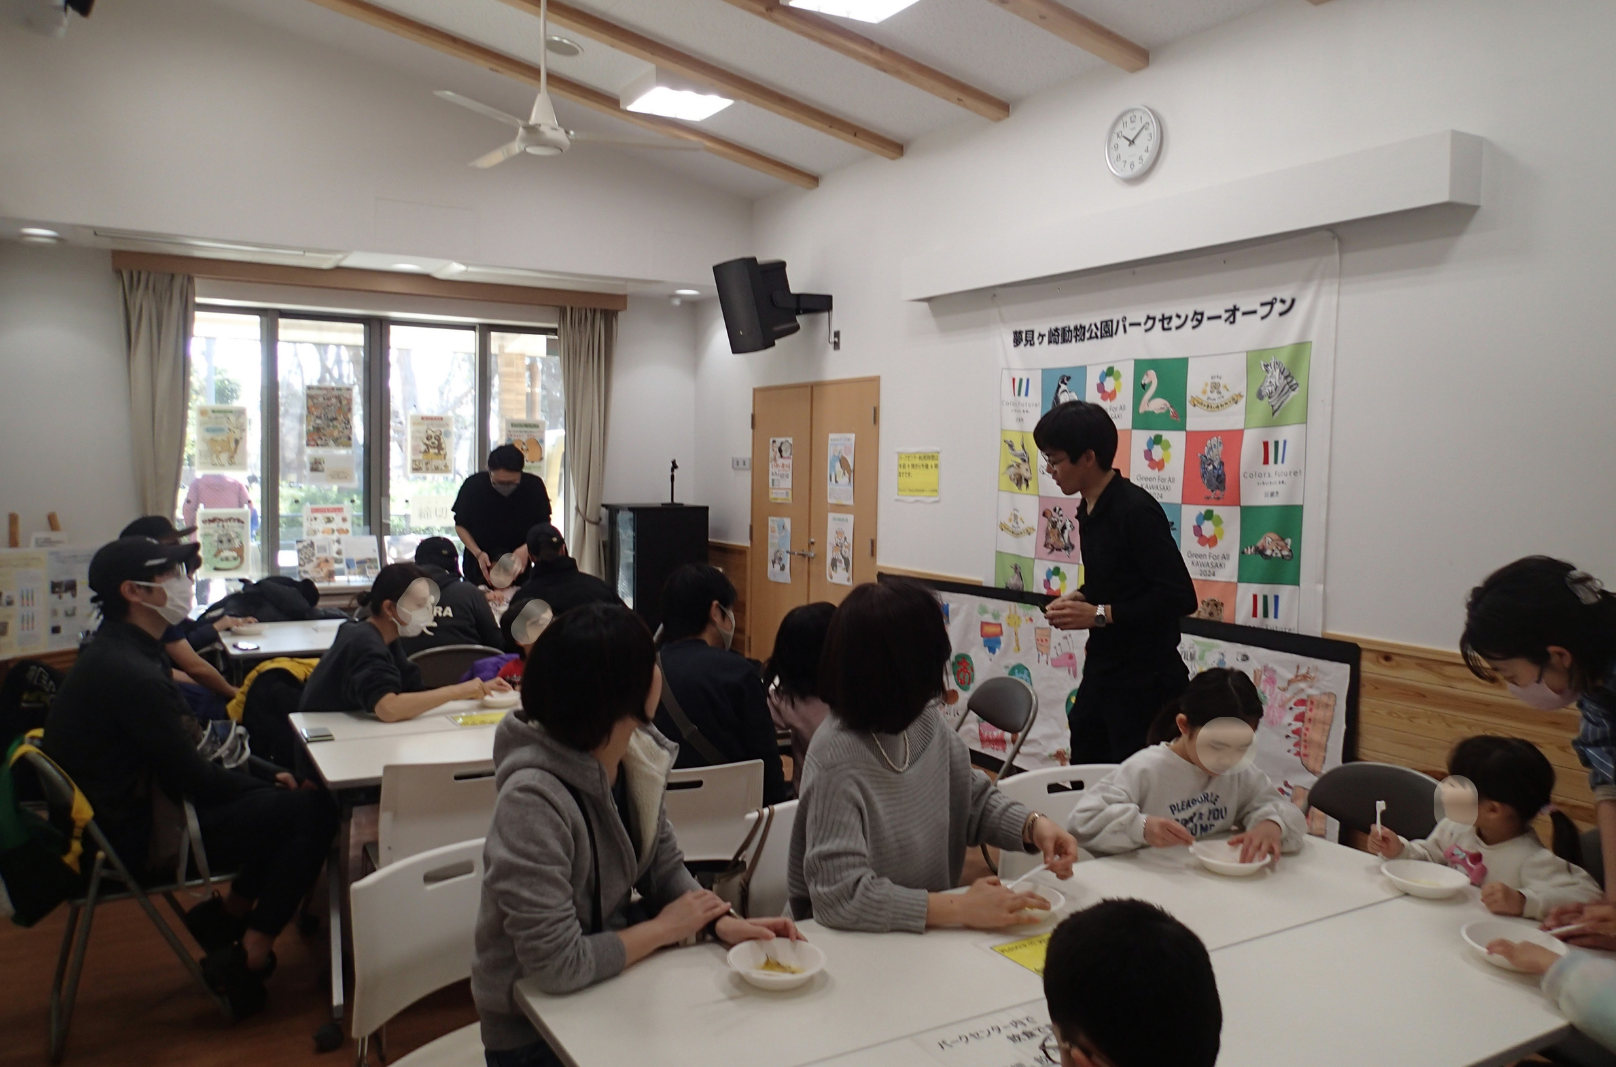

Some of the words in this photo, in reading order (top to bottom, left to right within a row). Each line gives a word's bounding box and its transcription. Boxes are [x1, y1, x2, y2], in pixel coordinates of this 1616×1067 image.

[1013, 297, 1296, 348] 夢見ヶ崎動物公園パークセンターオープン
[1136, 473, 1157, 483] Green
[1157, 475, 1167, 483] For
[1167, 476, 1176, 484] All
[1140, 483, 1172, 491] KAWASAKI
[1187, 549, 1208, 560] Green
[1208, 551, 1220, 560] For
[1221, 553, 1231, 561] All
[1191, 560, 1226, 569] KAWASAKI
[1199, 569, 1216, 577] 2024
